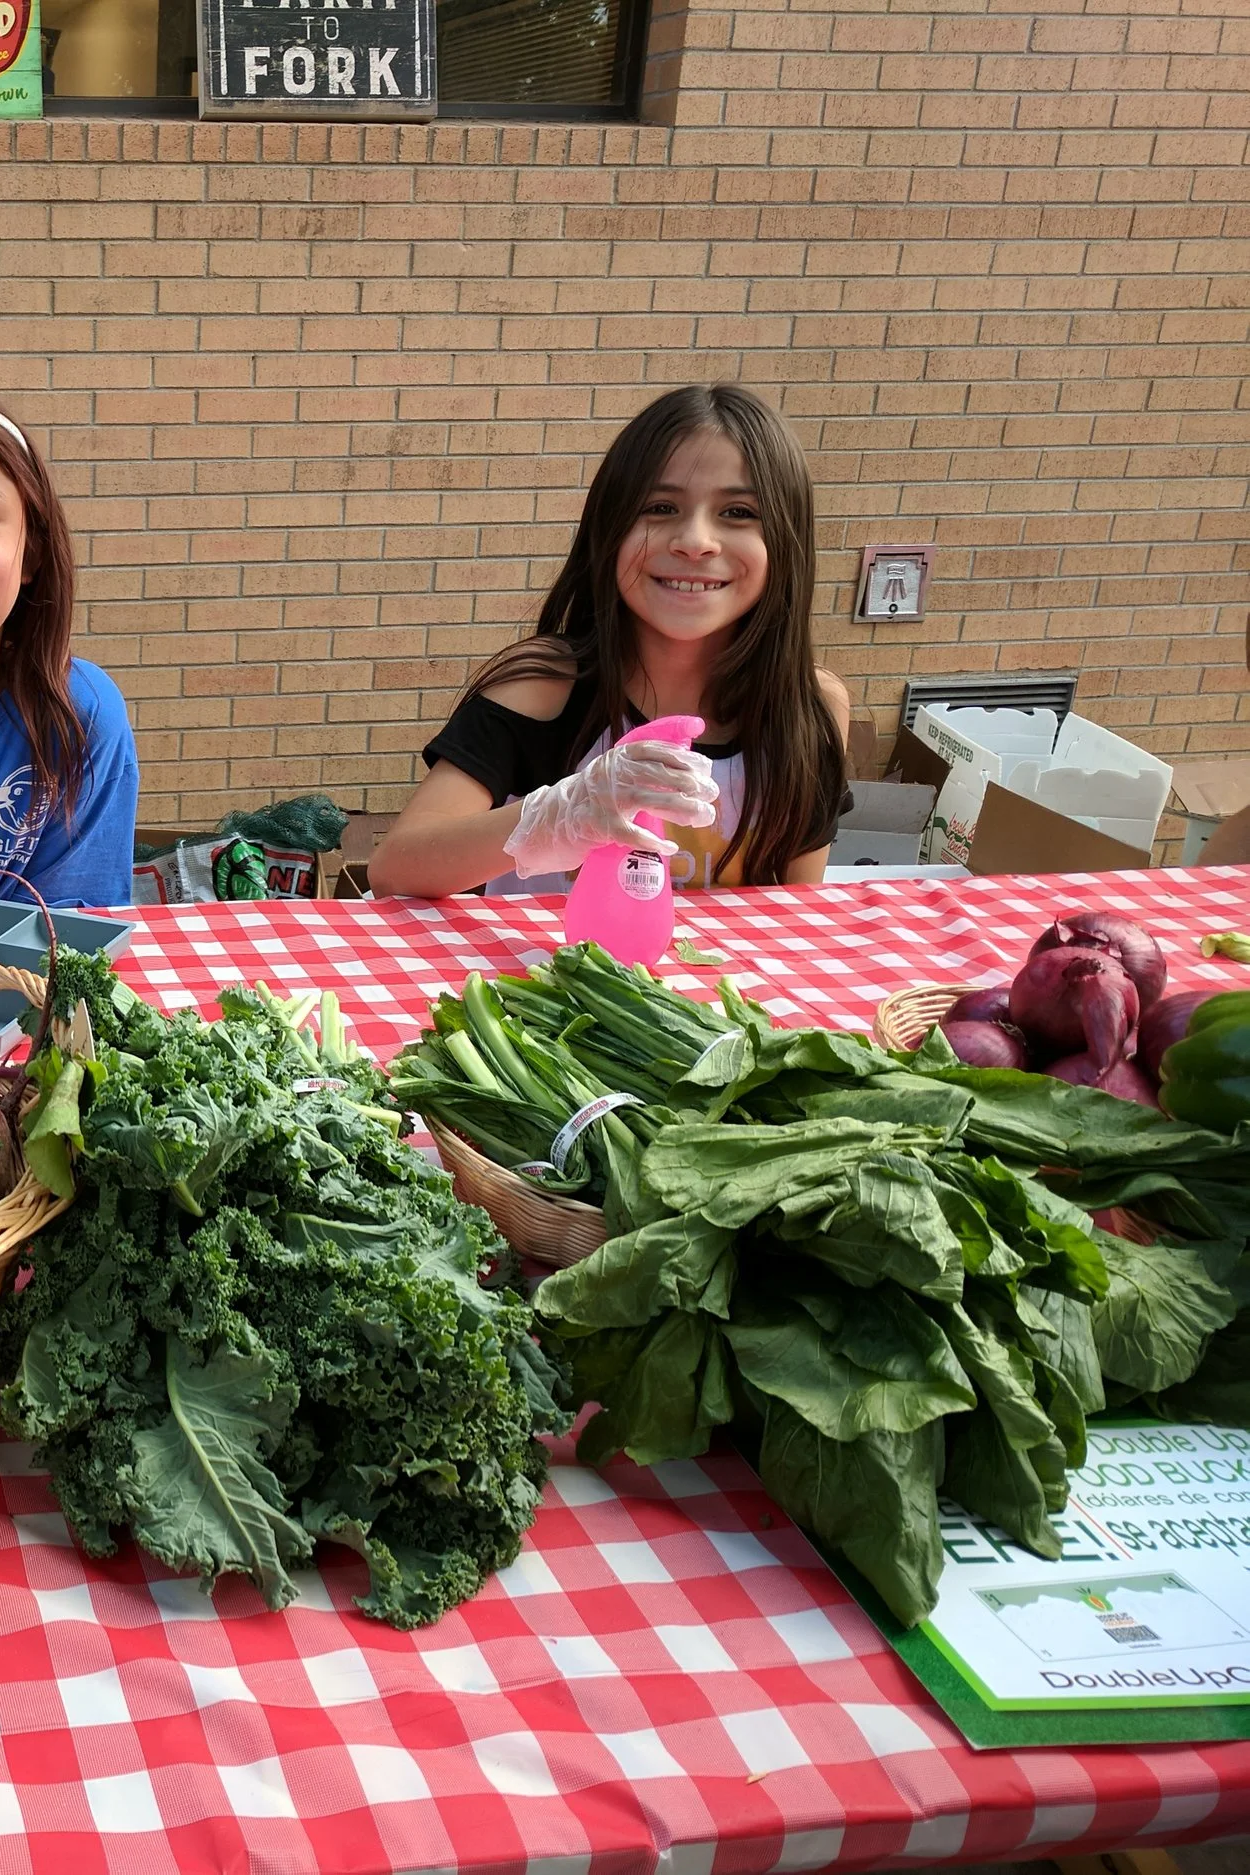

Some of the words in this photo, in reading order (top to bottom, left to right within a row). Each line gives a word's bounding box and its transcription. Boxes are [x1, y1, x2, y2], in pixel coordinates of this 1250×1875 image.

[301, 16, 340, 41] TO
[244, 46, 401, 96] FORK
[1086, 1431, 1198, 1455] Double
[1190, 1428, 1250, 1456] Up
[1066, 1463, 1155, 1487] OOD
[1152, 1458, 1250, 1485] BUCK
[1178, 1491, 1210, 1505] de
[1106, 1520, 1158, 1551] se
